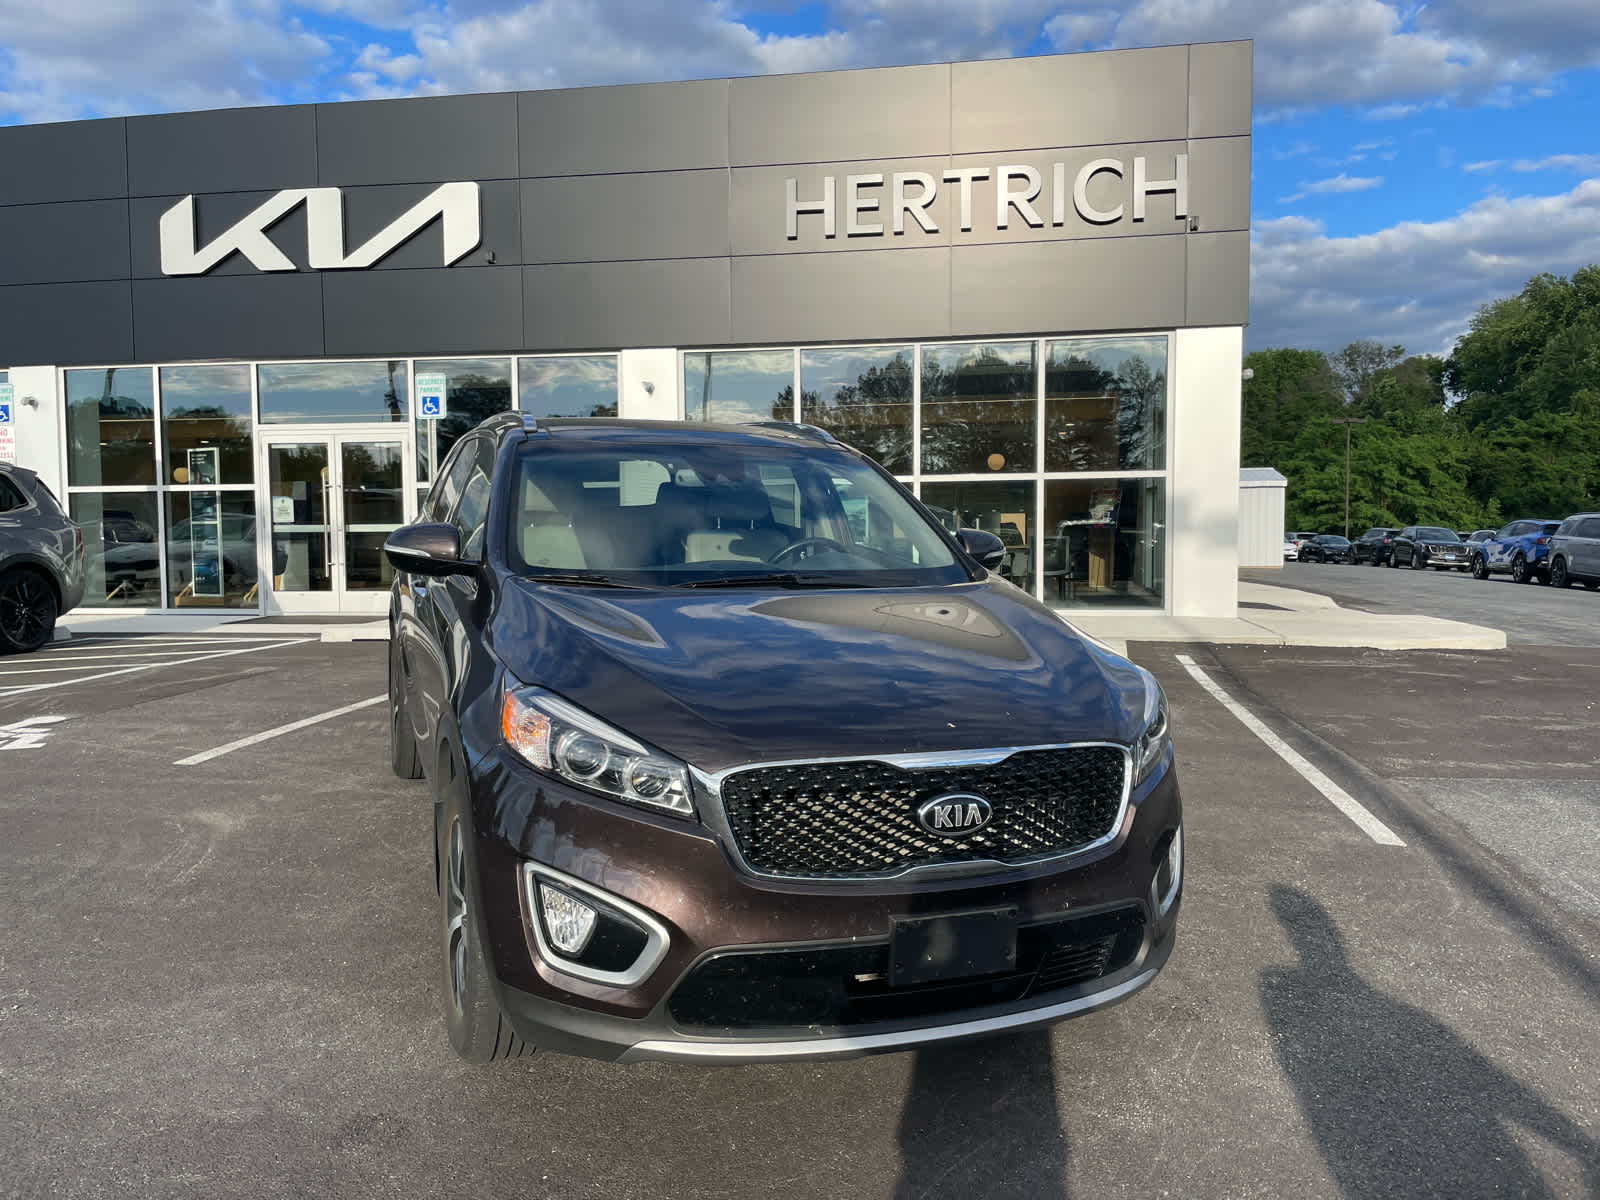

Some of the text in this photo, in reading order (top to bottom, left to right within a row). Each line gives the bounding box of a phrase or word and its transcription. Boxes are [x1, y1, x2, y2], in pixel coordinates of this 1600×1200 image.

[160, 181, 480, 276] KIA
[785, 154, 1188, 241] HERTRICH
[934, 803, 982, 828] KIA
